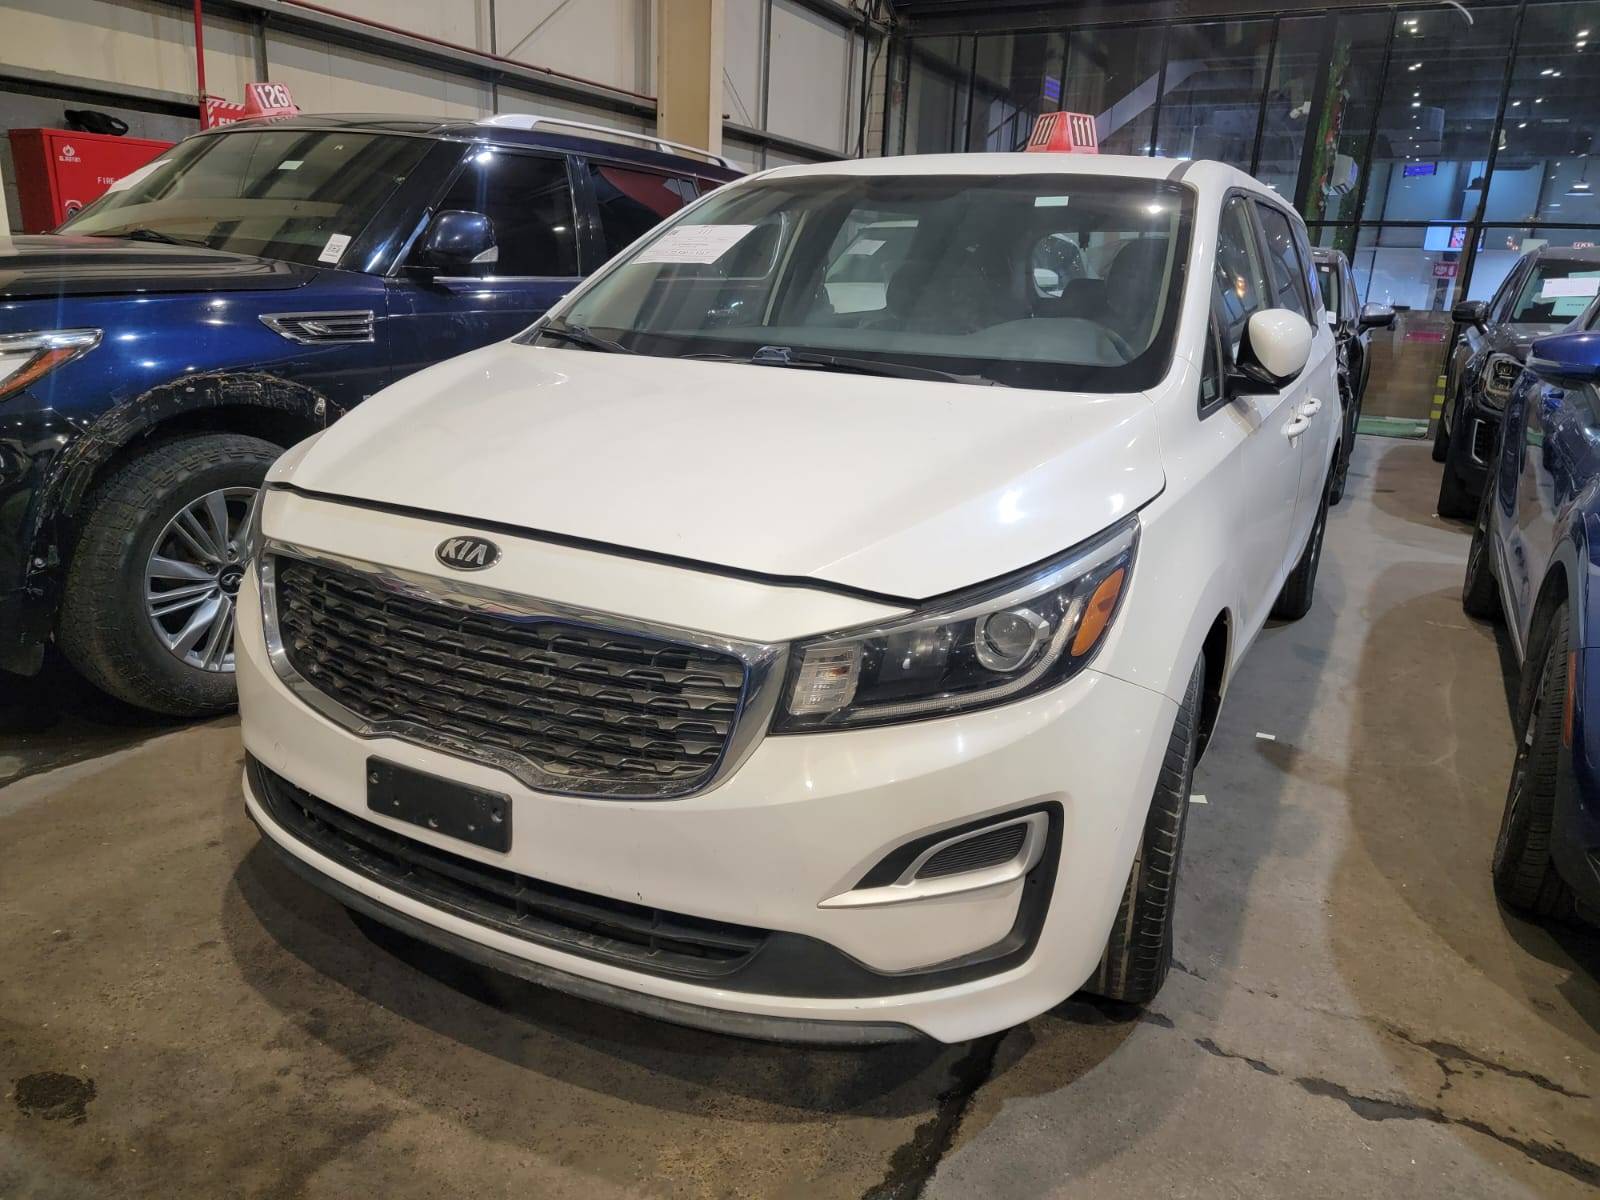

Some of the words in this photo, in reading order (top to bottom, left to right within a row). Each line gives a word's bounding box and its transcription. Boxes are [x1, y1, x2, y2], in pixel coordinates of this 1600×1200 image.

[257, 85, 289, 109] 126
[1073, 116, 1094, 147] 111
[441, 539, 488, 565] KIA
